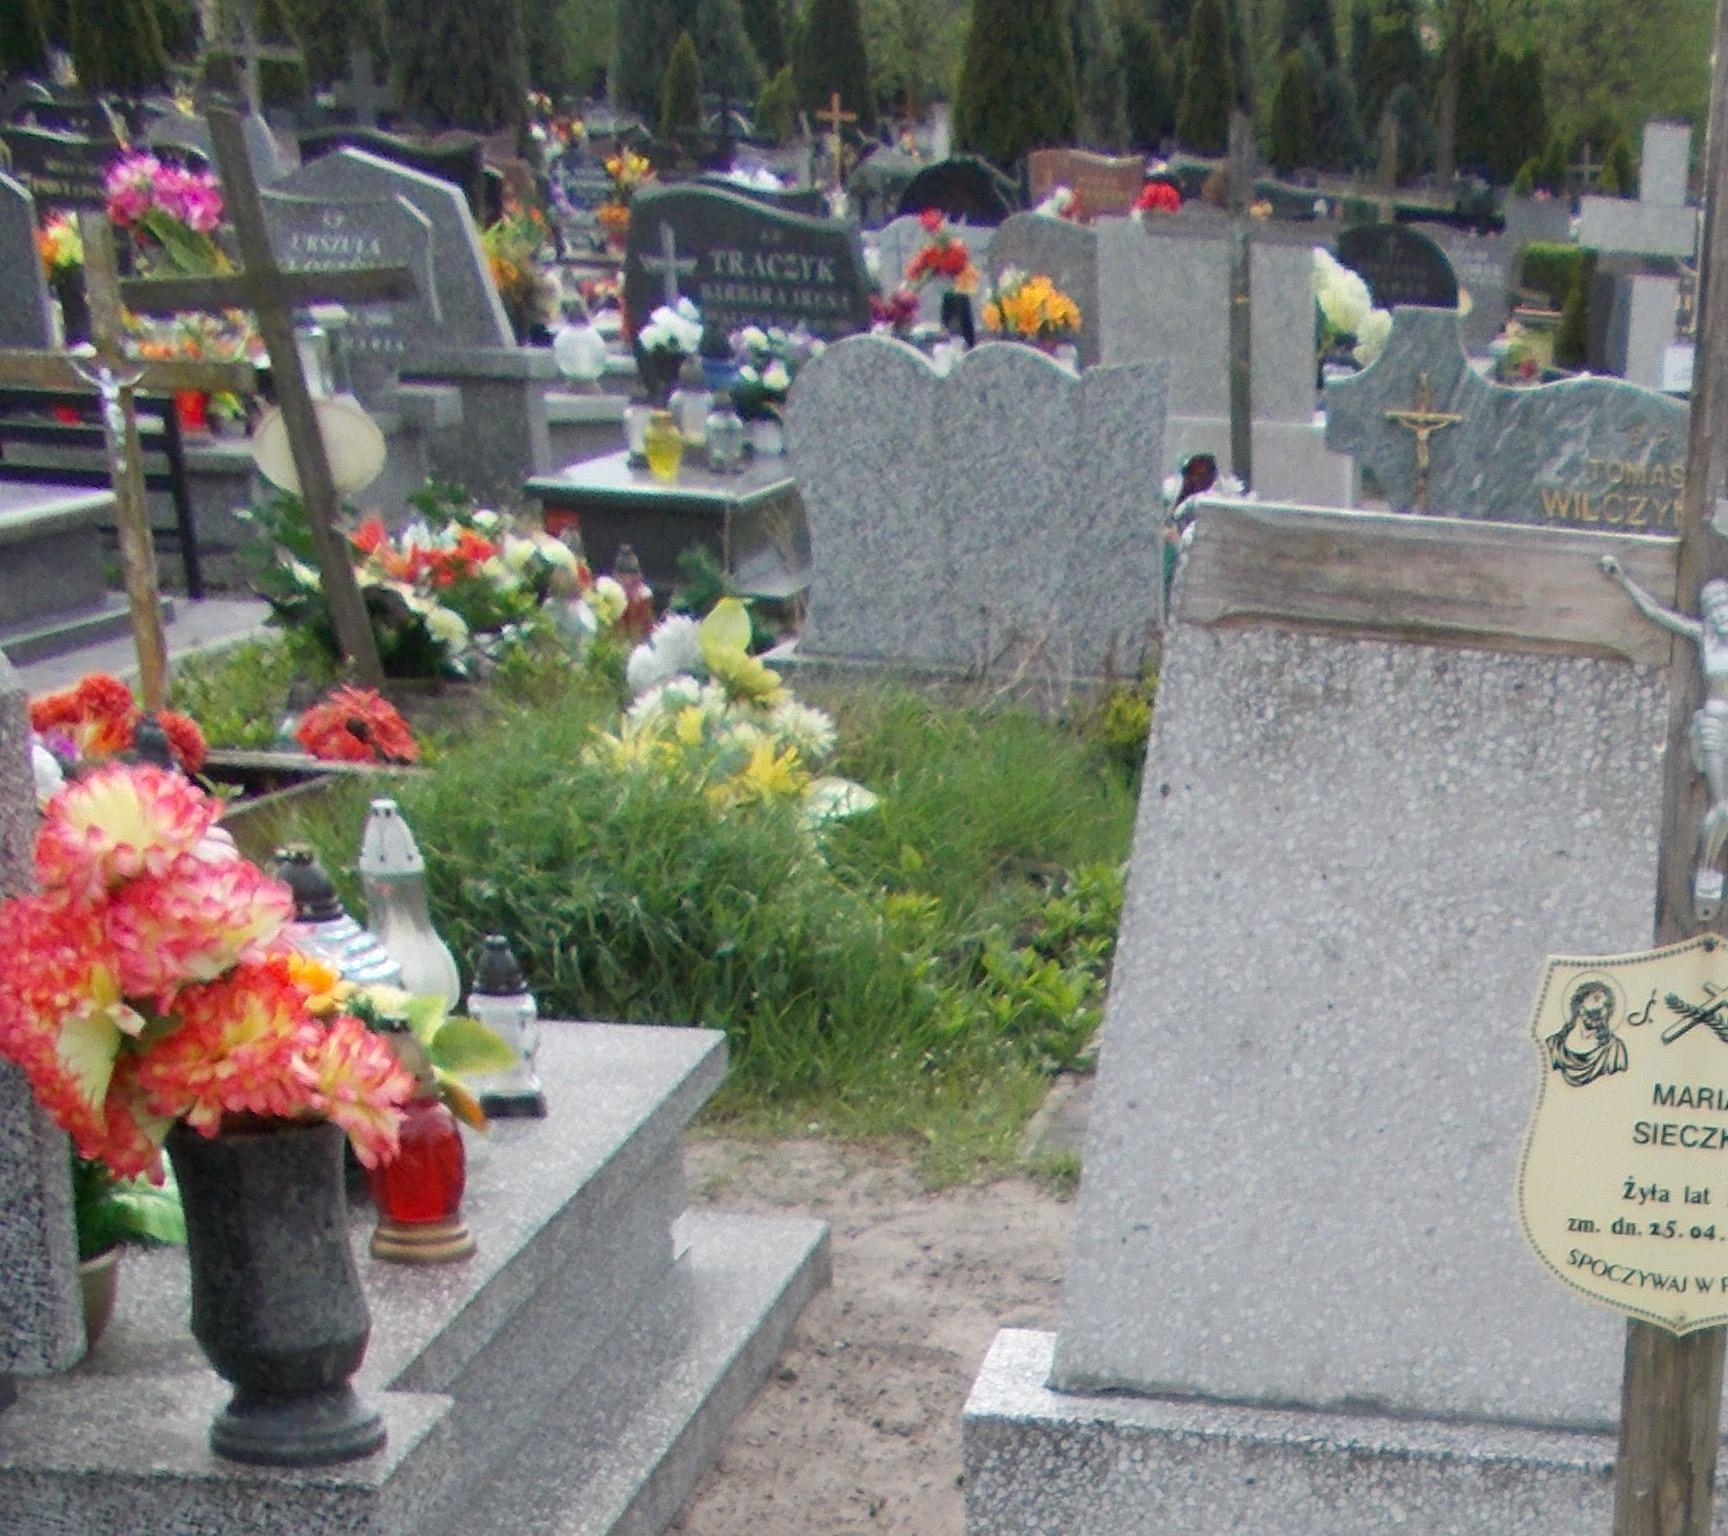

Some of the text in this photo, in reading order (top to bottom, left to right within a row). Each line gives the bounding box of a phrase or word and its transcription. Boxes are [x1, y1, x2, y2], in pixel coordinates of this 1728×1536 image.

[707, 248, 836, 284] TRACZYK
[1623, 1174, 1670, 1206] Żyła
[1683, 1185, 1711, 1205] lat
[1567, 1217, 1600, 1234] zm.
[1610, 1216, 1642, 1236] dn.
[1567, 1247, 1688, 1293] SPOCZYWAJ
[1694, 1275, 1714, 1293] W
